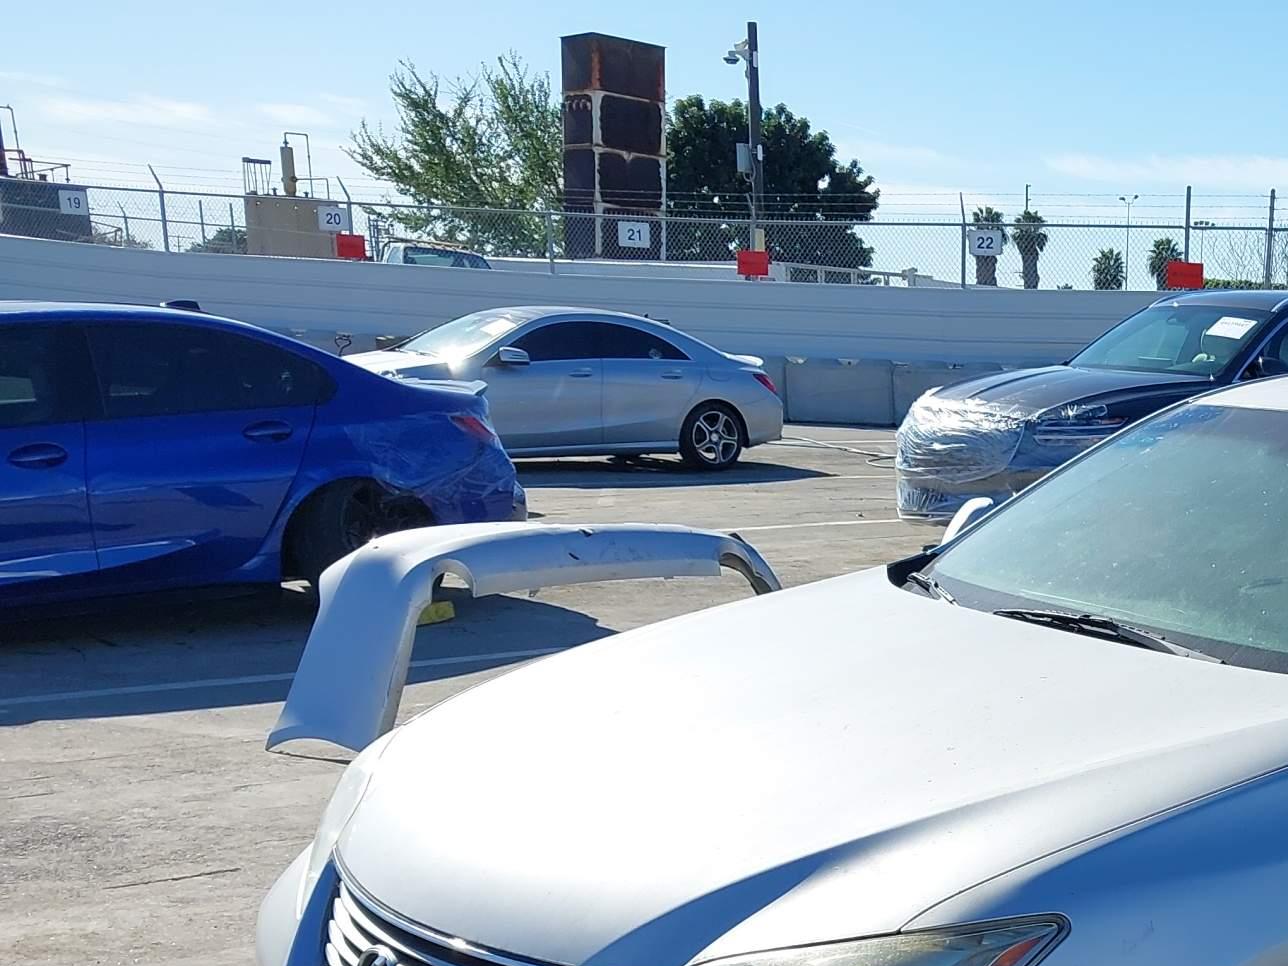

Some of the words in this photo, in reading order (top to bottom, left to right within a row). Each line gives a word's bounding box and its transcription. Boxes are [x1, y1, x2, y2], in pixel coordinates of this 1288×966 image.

[67, 197, 81, 209] 19
[326, 212, 341, 225] 20
[627, 228, 642, 241] 21
[976, 236, 994, 250] 22
